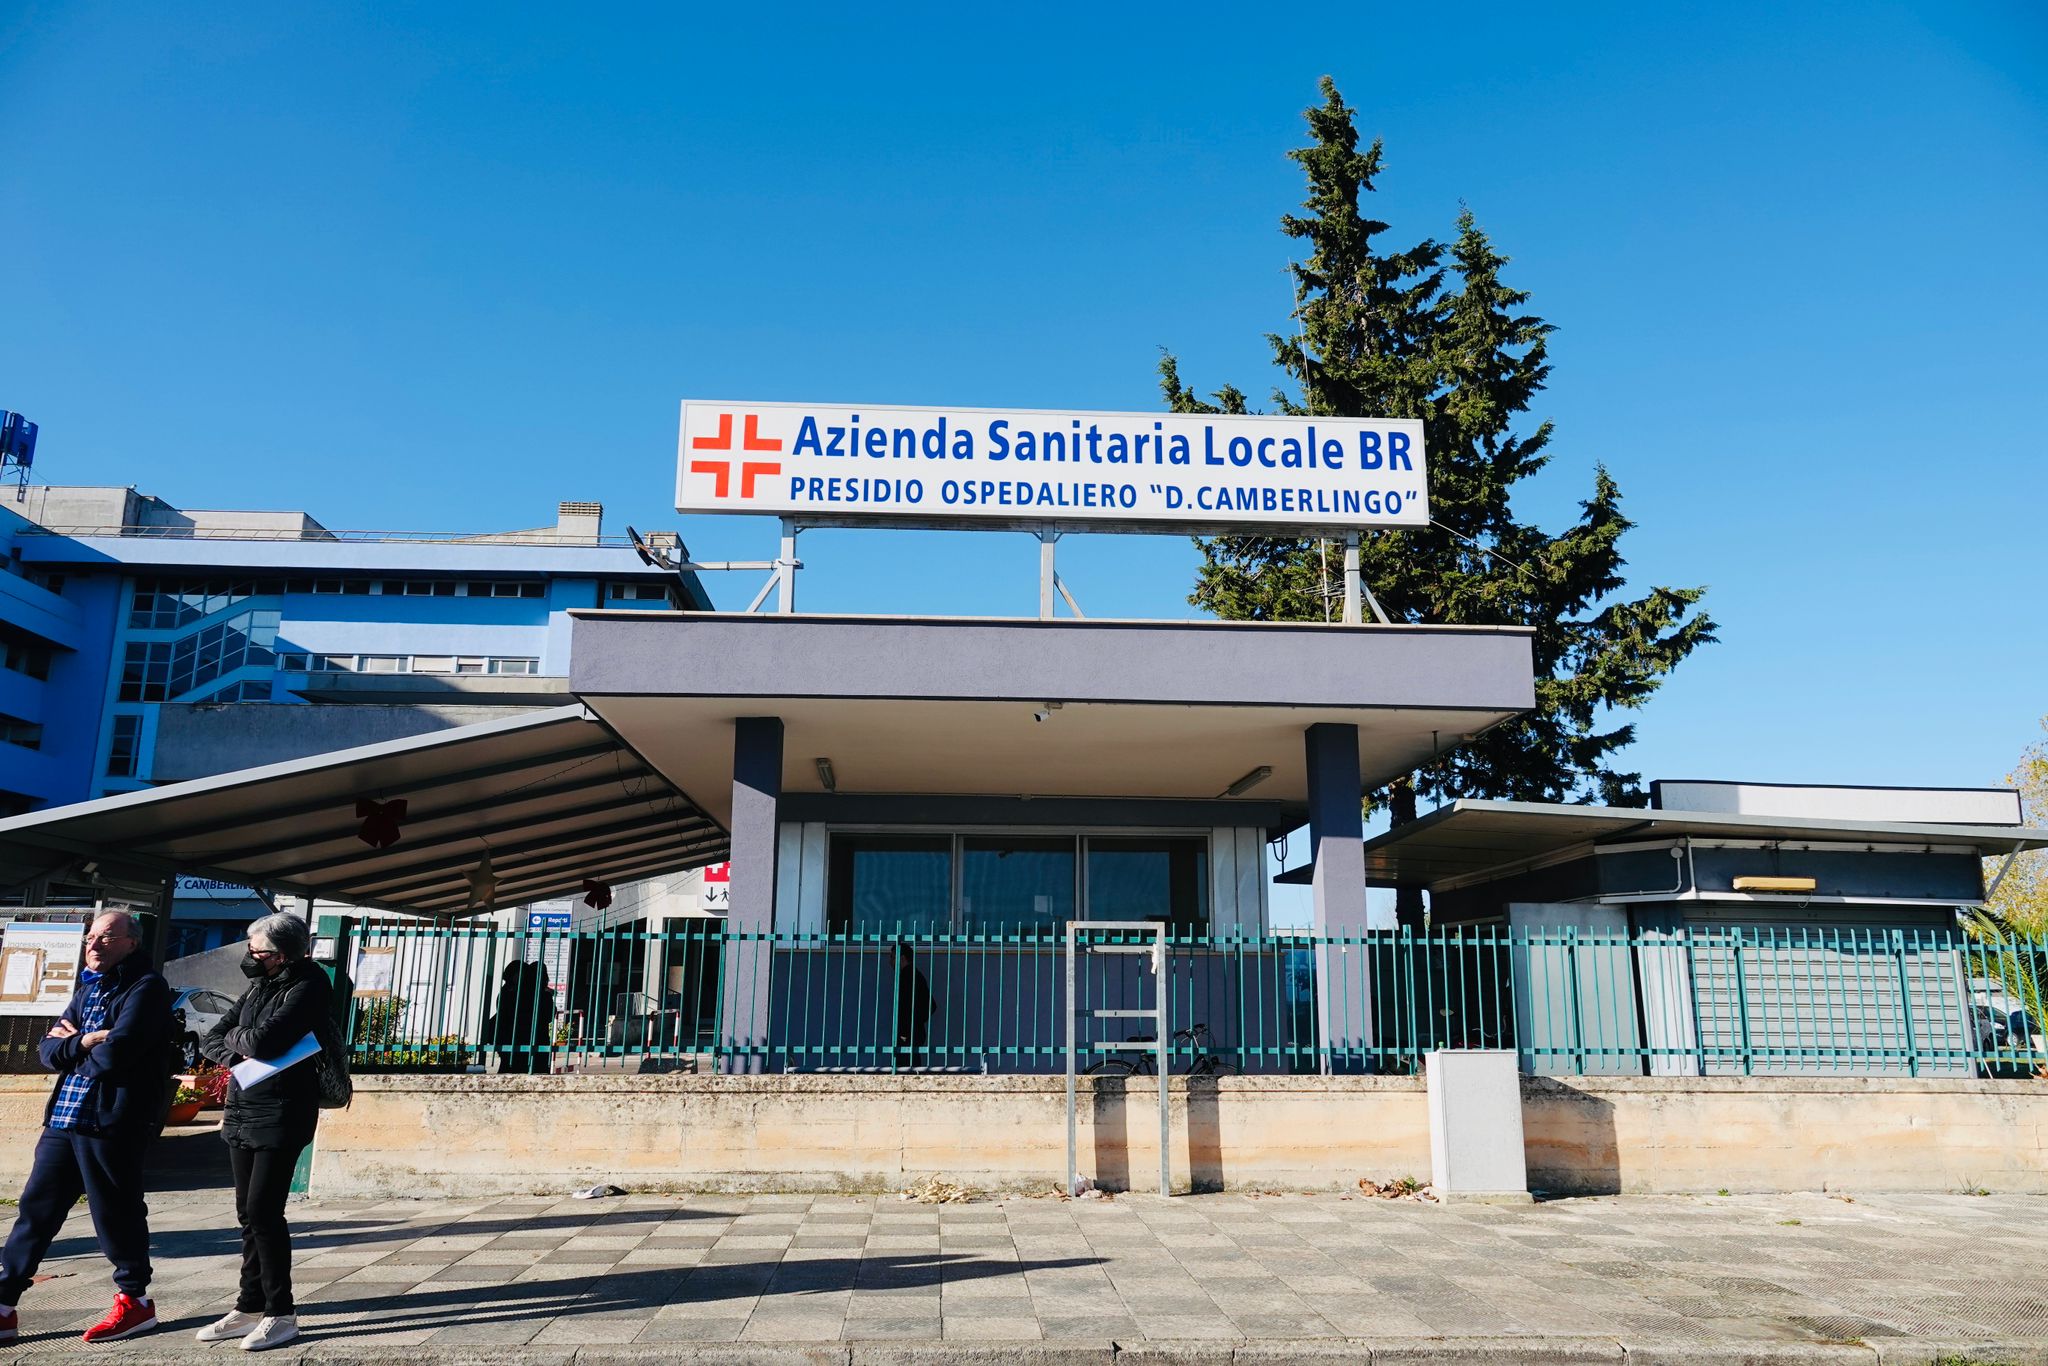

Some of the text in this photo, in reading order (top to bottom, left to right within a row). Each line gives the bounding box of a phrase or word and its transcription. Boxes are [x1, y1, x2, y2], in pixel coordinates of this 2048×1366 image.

[793, 415, 1413, 471] Azienda Sanitaria Locale BR
[790, 477, 1418, 515] PRESIDIO OSPEDALIERO "D.CAMBERLINGO"
